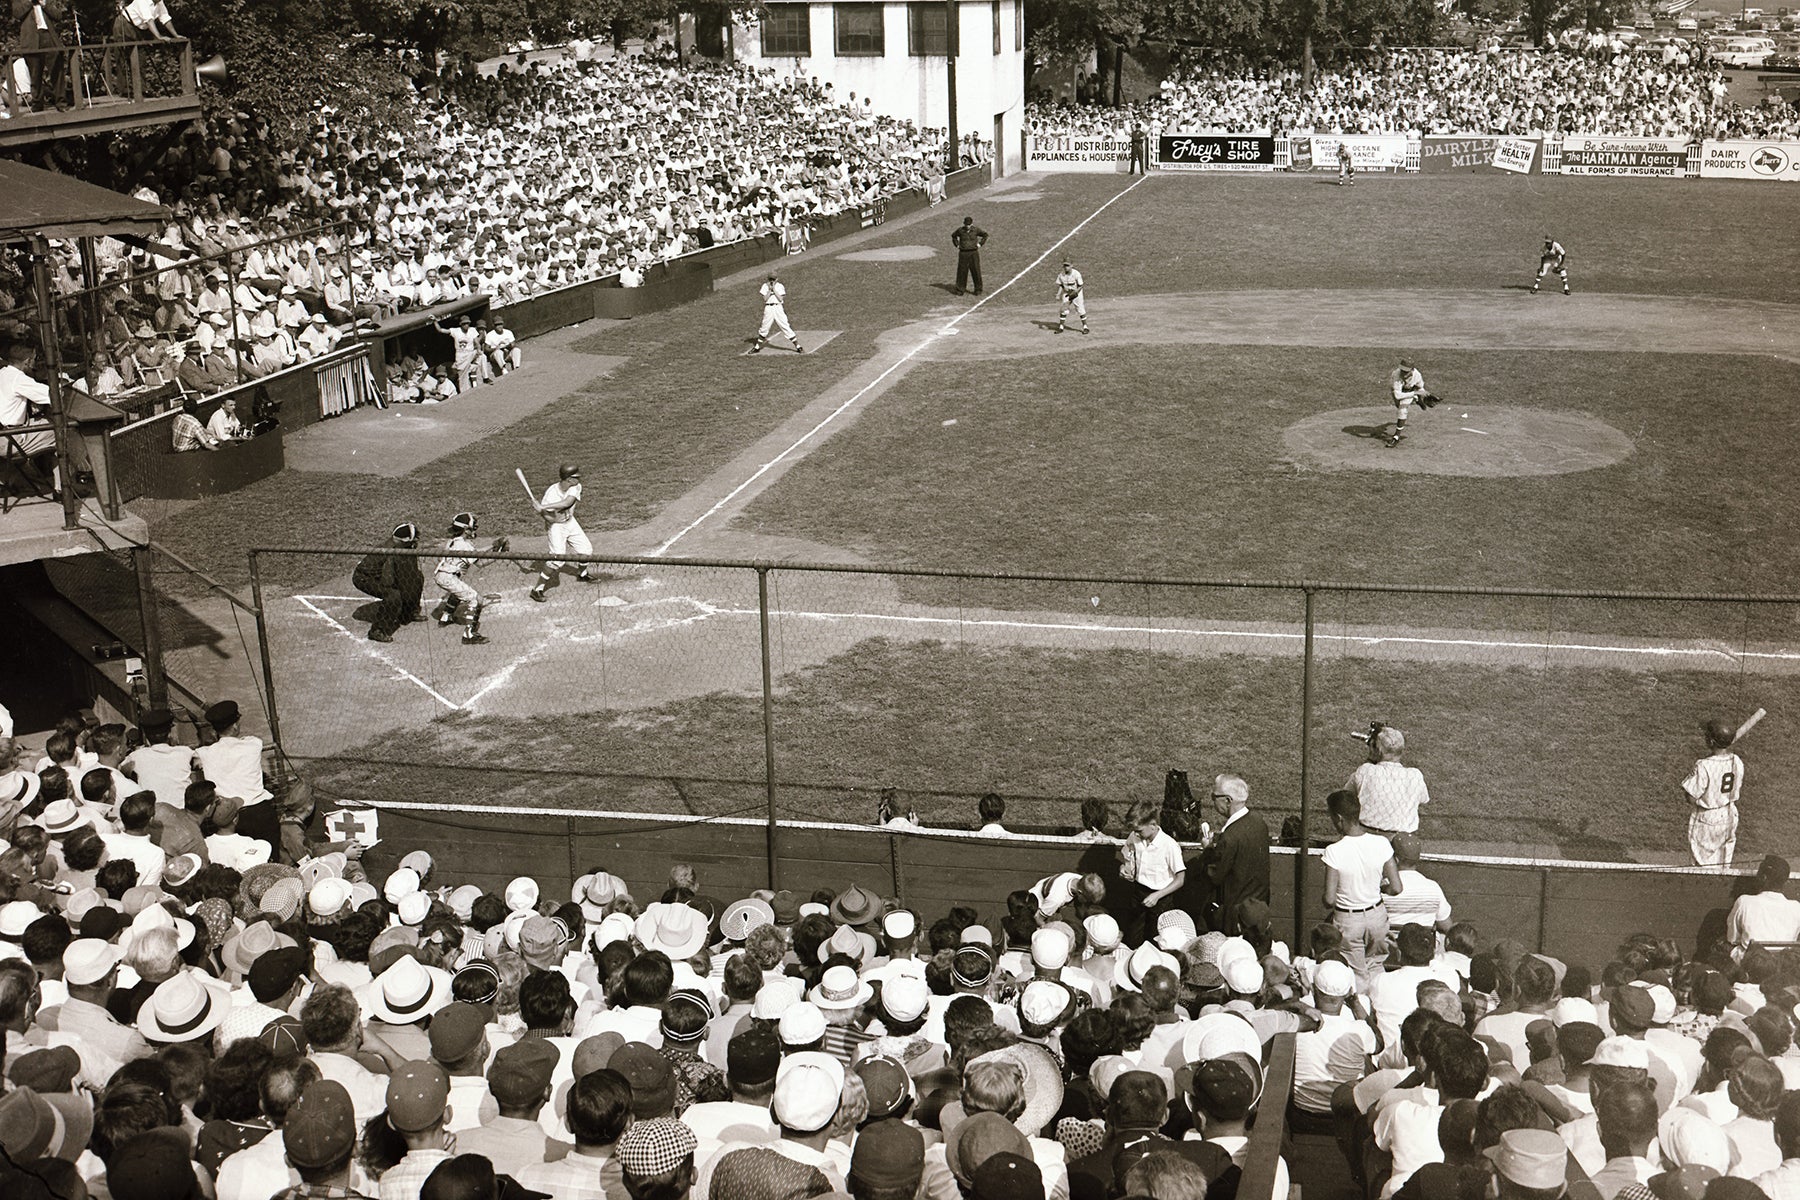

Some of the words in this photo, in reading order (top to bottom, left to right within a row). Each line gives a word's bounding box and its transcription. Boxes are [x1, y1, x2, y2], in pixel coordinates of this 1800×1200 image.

[1172, 139, 1221, 163] Frey's
[1227, 141, 1259, 150] TIRE
[1584, 141, 1596, 151] Be
[1648, 143, 1668, 152] With
[1031, 153, 1079, 161] APPLIANCES
[1081, 153, 1087, 161] &
[1089, 153, 1137, 161] HOUSEWAR
[1227, 151, 1261, 160] SHOP
[1451, 152, 1495, 167] MILK
[1501, 147, 1530, 161] HEALTH
[1566, 152, 1580, 162] The
[1581, 152, 1637, 165] HARTMAN
[1640, 154, 1680, 167] Agency
[1711, 150, 1740, 158] DAIRY
[1704, 160, 1746, 169] PRODUCTS
[1720, 772, 1735, 793] 8
